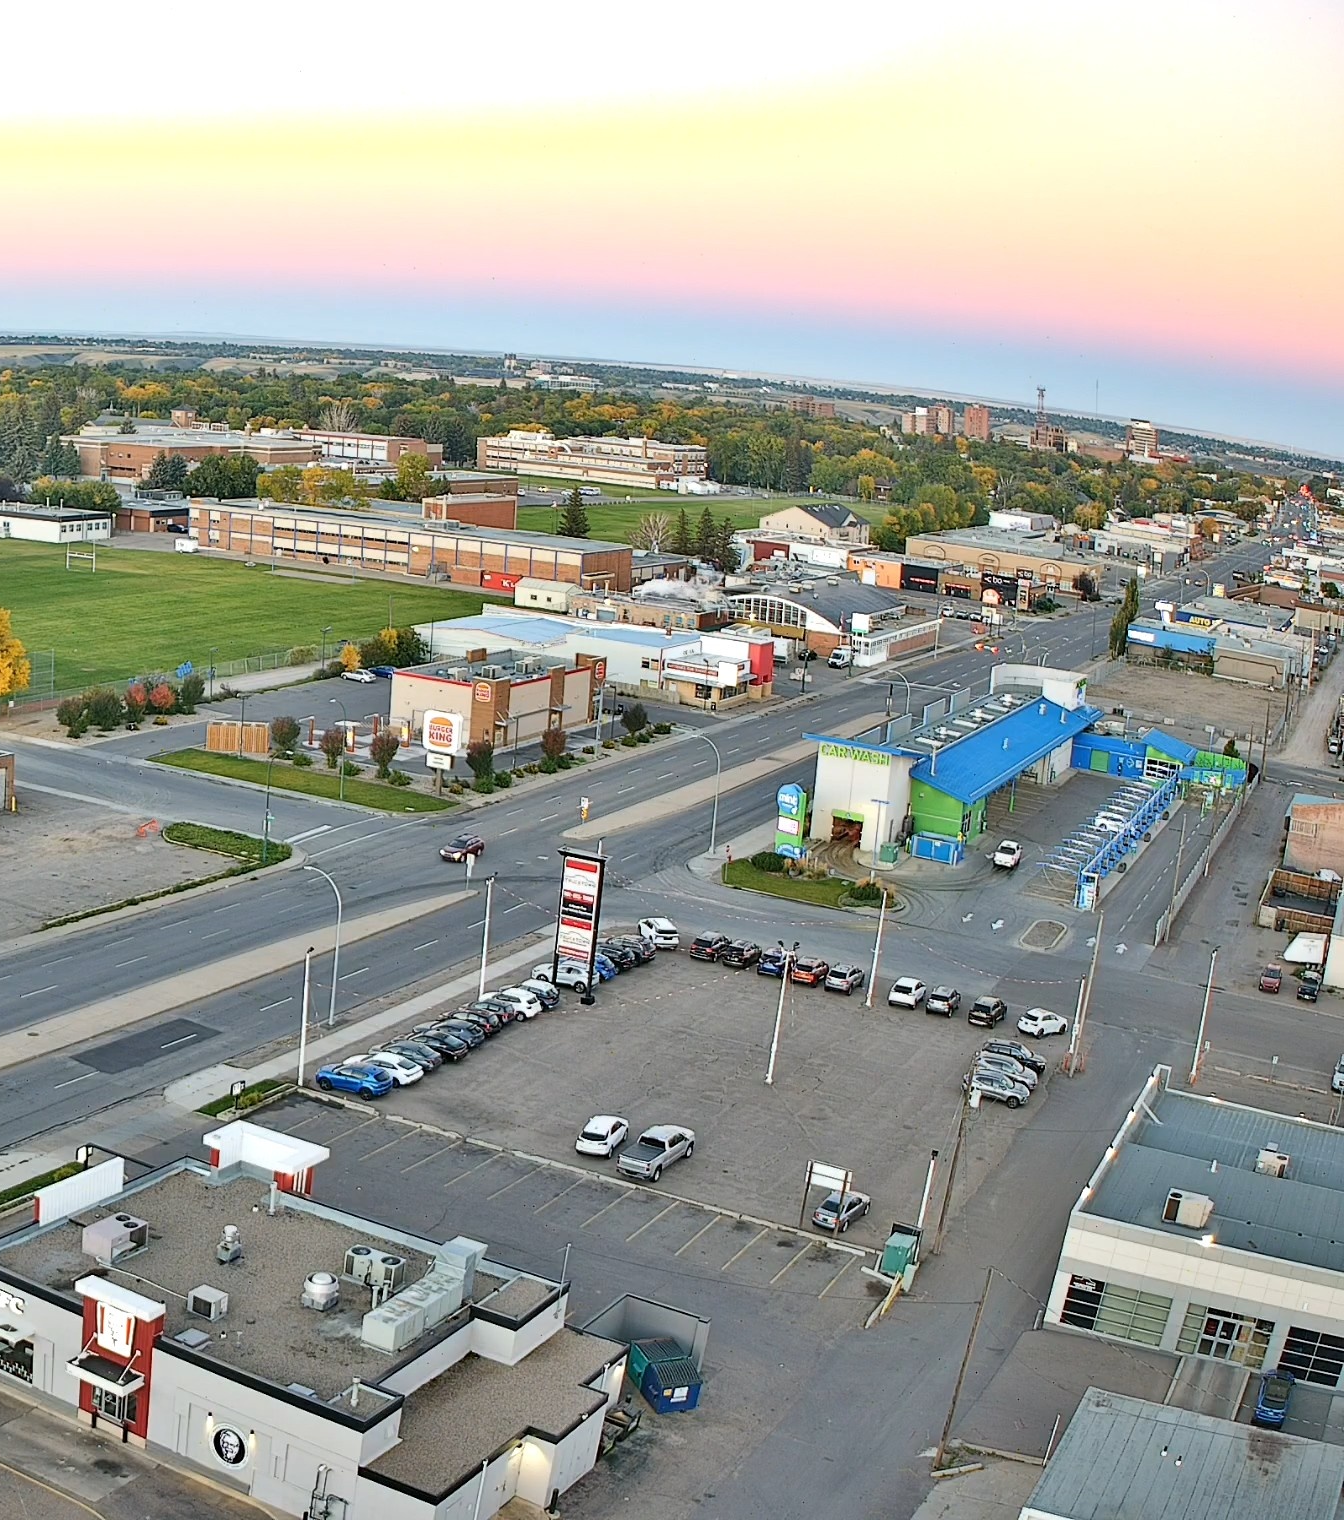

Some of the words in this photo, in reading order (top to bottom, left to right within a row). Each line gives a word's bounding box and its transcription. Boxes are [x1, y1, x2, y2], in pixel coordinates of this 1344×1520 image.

[1189, 615, 1211, 627] AUTO
[429, 724, 453, 734] BURGER
[428, 731, 453, 743] KING
[821, 744, 847, 759] CAR
[850, 747, 891, 767] WASH
[778, 791, 798, 805] mint
